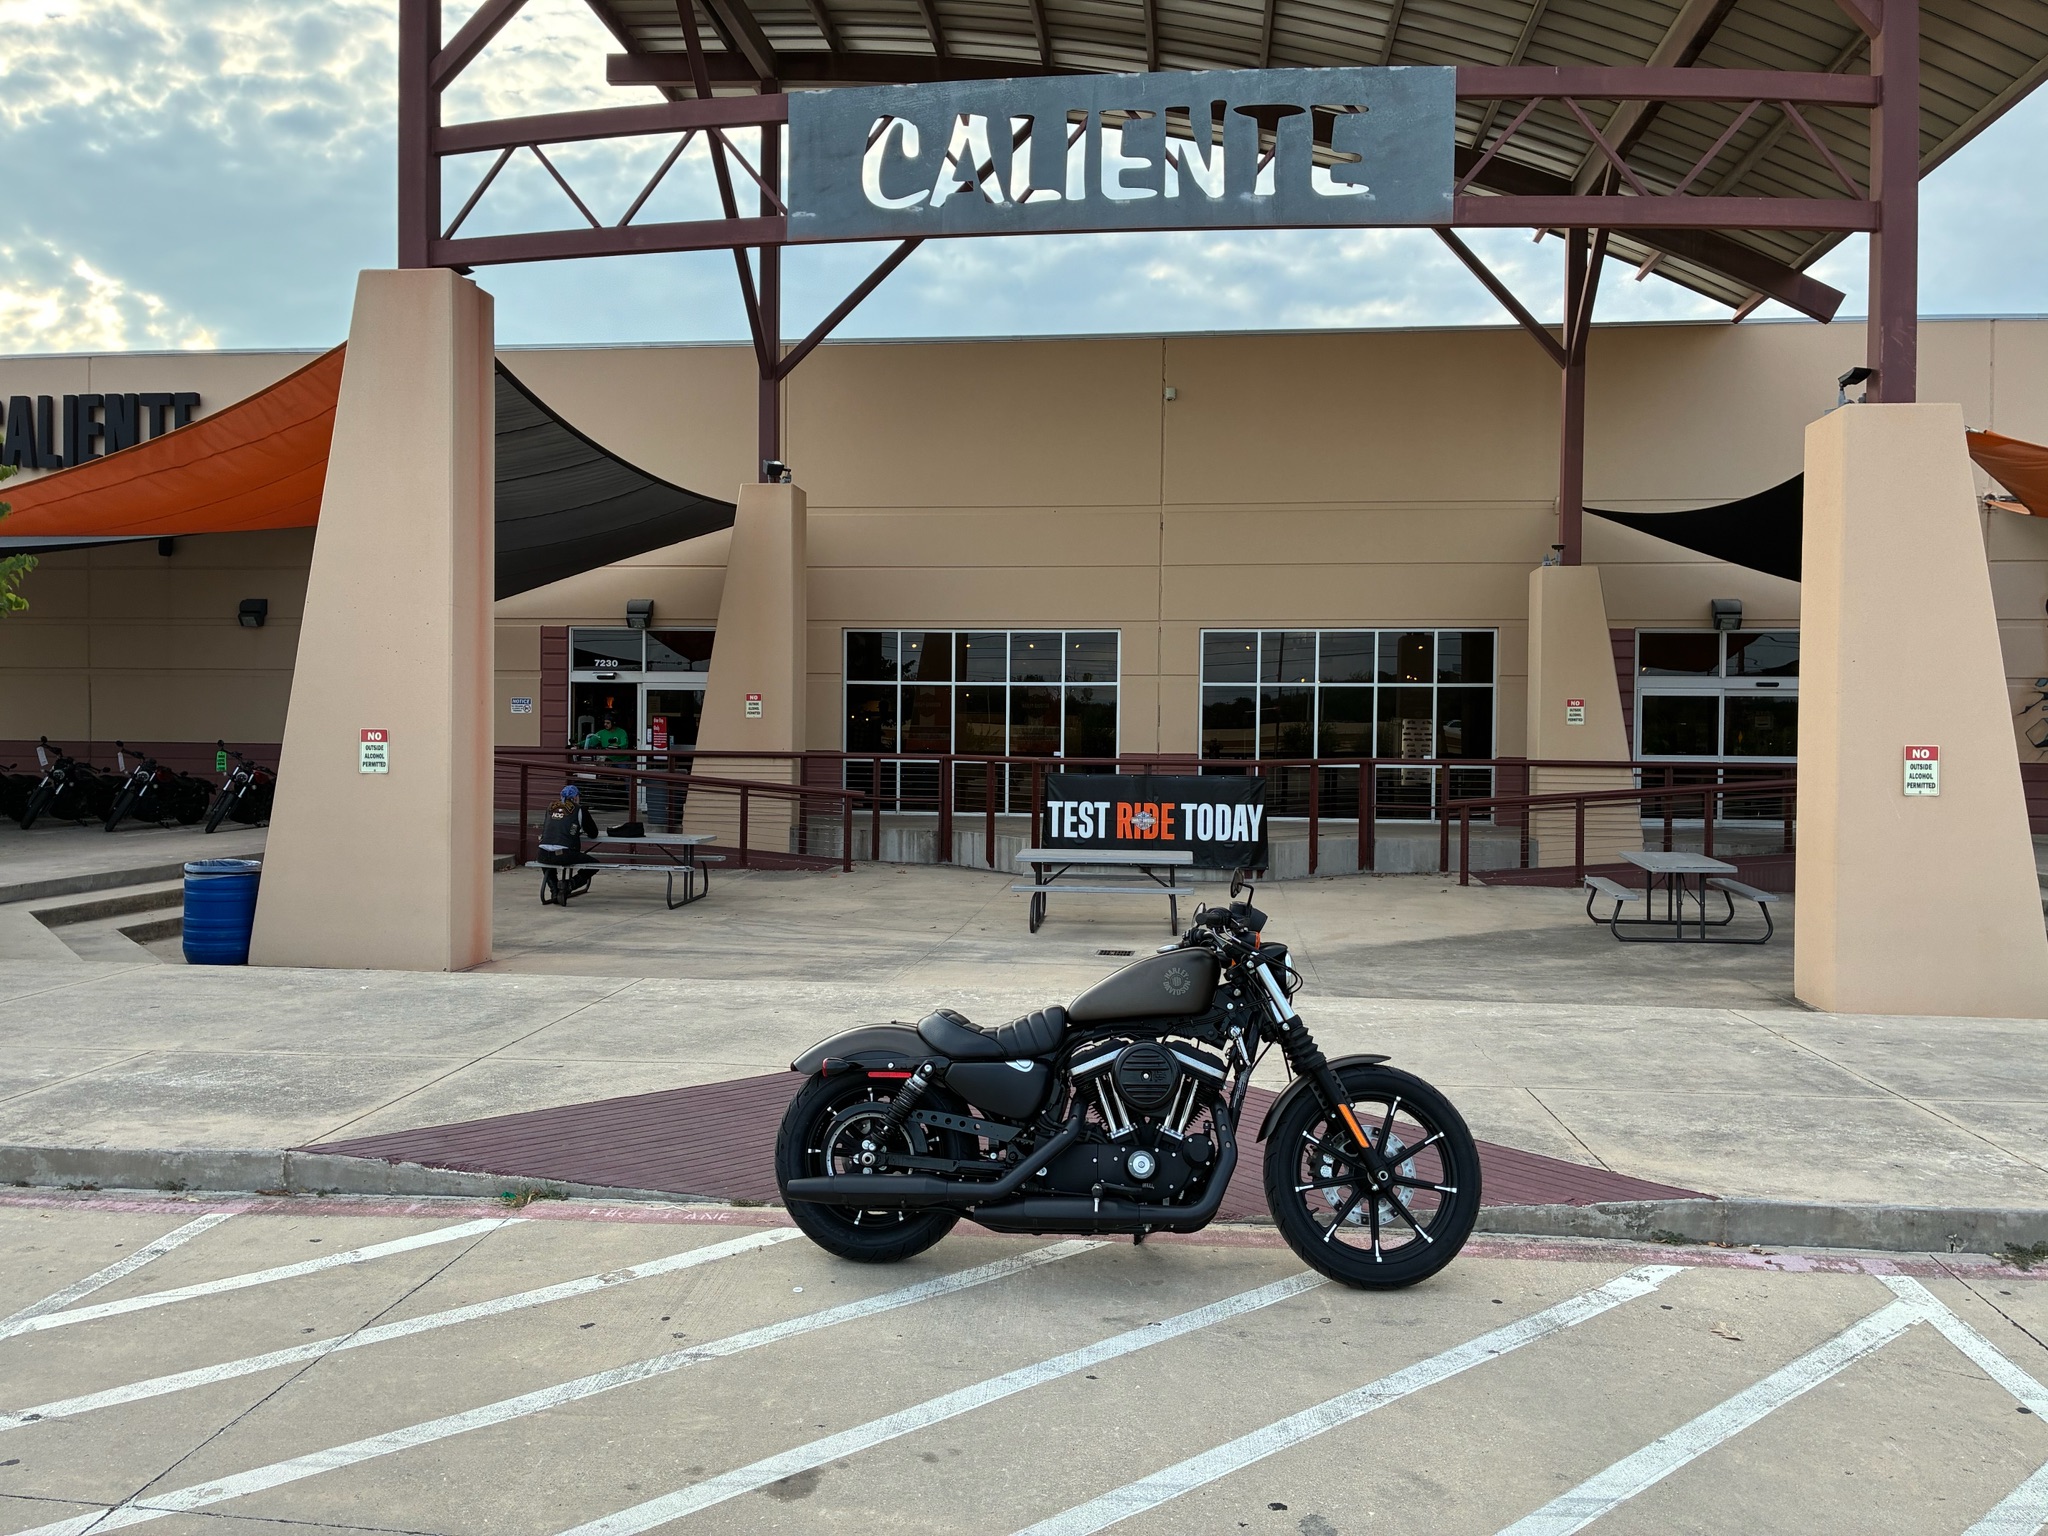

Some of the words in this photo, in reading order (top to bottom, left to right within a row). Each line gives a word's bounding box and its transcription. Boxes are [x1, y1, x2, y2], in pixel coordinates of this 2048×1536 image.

[860, 99, 1370, 209] CALIENTE
[0, 391, 201, 469] ALIENT
[594, 659, 618, 667] 7230
[367, 731, 382, 740] NO
[1912, 749, 1930, 759] NO
[1047, 801, 1111, 839] TEST
[1116, 802, 1176, 840] RIDE
[1181, 803, 1264, 842] TODAY
[1164, 967, 1190, 979] HARLEY
[1162, 979, 1191, 996] DAVIDSON
